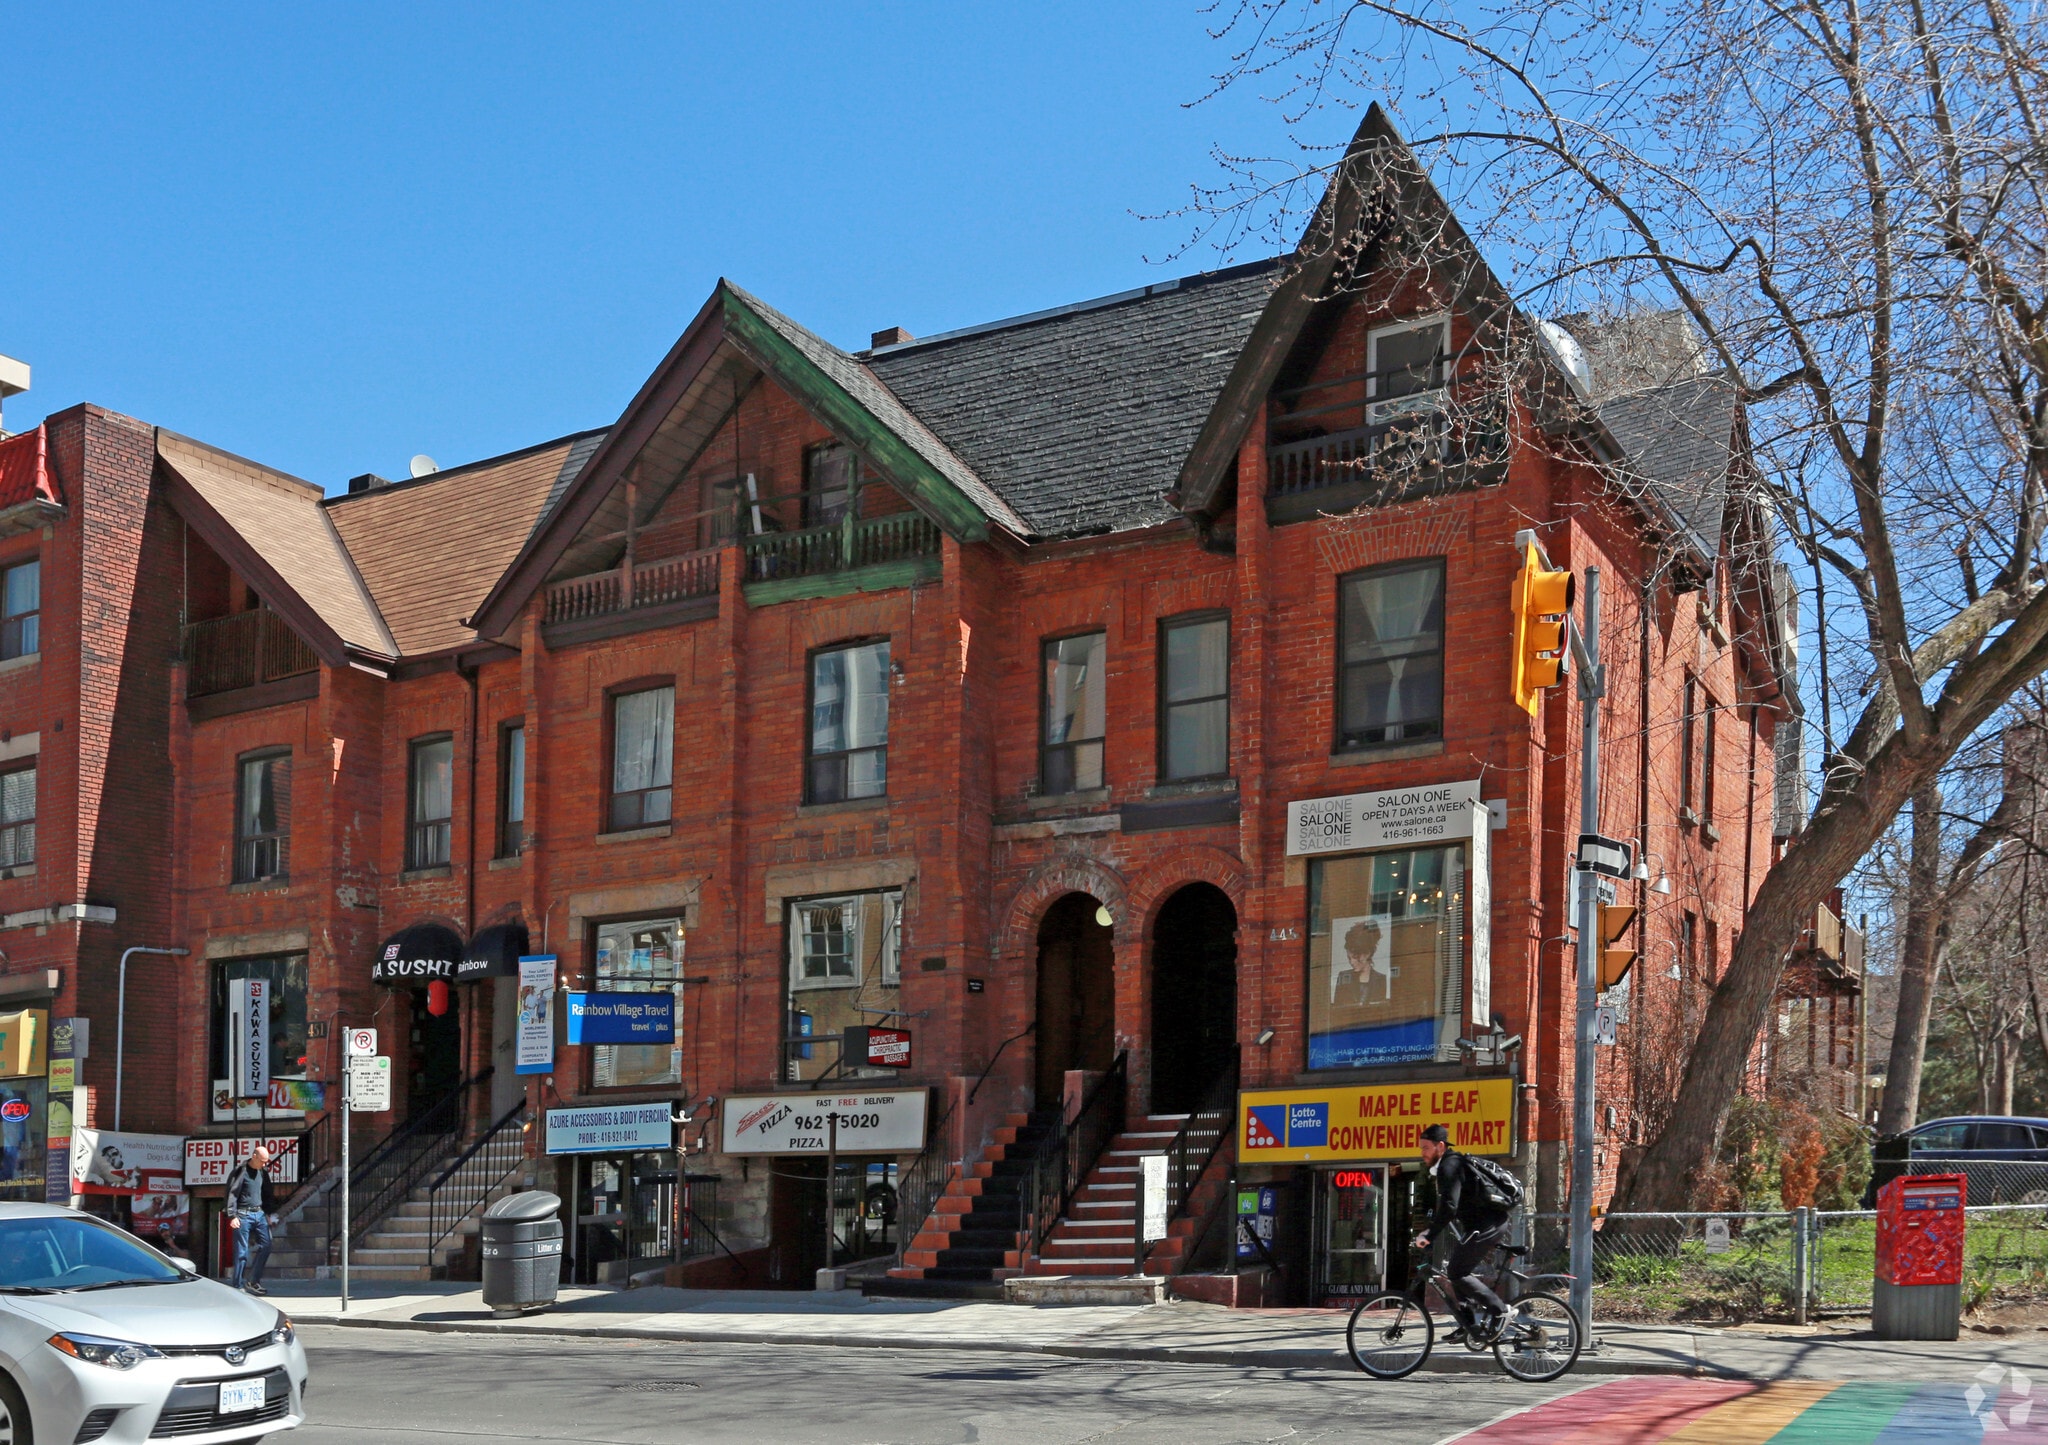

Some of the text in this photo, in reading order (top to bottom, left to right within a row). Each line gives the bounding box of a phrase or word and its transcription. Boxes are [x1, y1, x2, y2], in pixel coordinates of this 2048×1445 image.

[1377, 789, 1452, 808] SALON ONE
[1300, 799, 1353, 815] SALONE
[1361, 801, 1467, 821] OPEN 7 DAYS A WEEK
[1299, 811, 1352, 827] SALONE
[1381, 815, 1447, 829] www.salone.ca
[1299, 823, 1352, 839] SALONE
[1382, 825, 1444, 840] 416-961-1663
[1298, 834, 1351, 851] SALONE
[387, 959, 453, 976] SUSHI
[571, 1003, 669, 1019] Rainbow Village Travel
[631, 1022, 668, 1033] travel plus
[251, 999, 261, 1091] KAWA SUSHI
[868, 1033, 898, 1046] ACUPUNCTURE
[873, 1043, 902, 1055] CHIROPRACTIC
[1337, 1048, 1355, 1056] HAIR
[816, 1096, 896, 1107] FAST FREE DELIVERY
[1359, 1090, 1479, 1118] MAPLE LEAF
[3, 1103, 30, 1116] OPEN
[1291, 1106, 1316, 1118] Lotto
[549, 1108, 669, 1129] AZURE ACCESSORIES & BODY PIERCING
[758, 1104, 793, 1134] PIZZA
[794, 1113, 880, 1130] 962 5020
[1291, 1117, 1321, 1128] Centre
[578, 1132, 596, 1143] PHONE
[601, 1130, 638, 1142] 416-921-0412
[1456, 1120, 1505, 1147] MART
[123, 1141, 145, 1149] Health
[146, 1142, 176, 1151] Nutrition
[187, 1141, 224, 1157] FEED
[255, 1138, 297, 1155] ORE
[789, 1137, 824, 1148] PIZZA
[147, 1153, 164, 1162] Dogs
[201, 1160, 228, 1175] PET
[200, 1176, 222, 1184] DELIVER
[1335, 1171, 1373, 1188] OPEN
[537, 1243, 554, 1253] Litter
[1350, 1284, 1363, 1295] AND
[248, 1386, 263, 1401] 782
